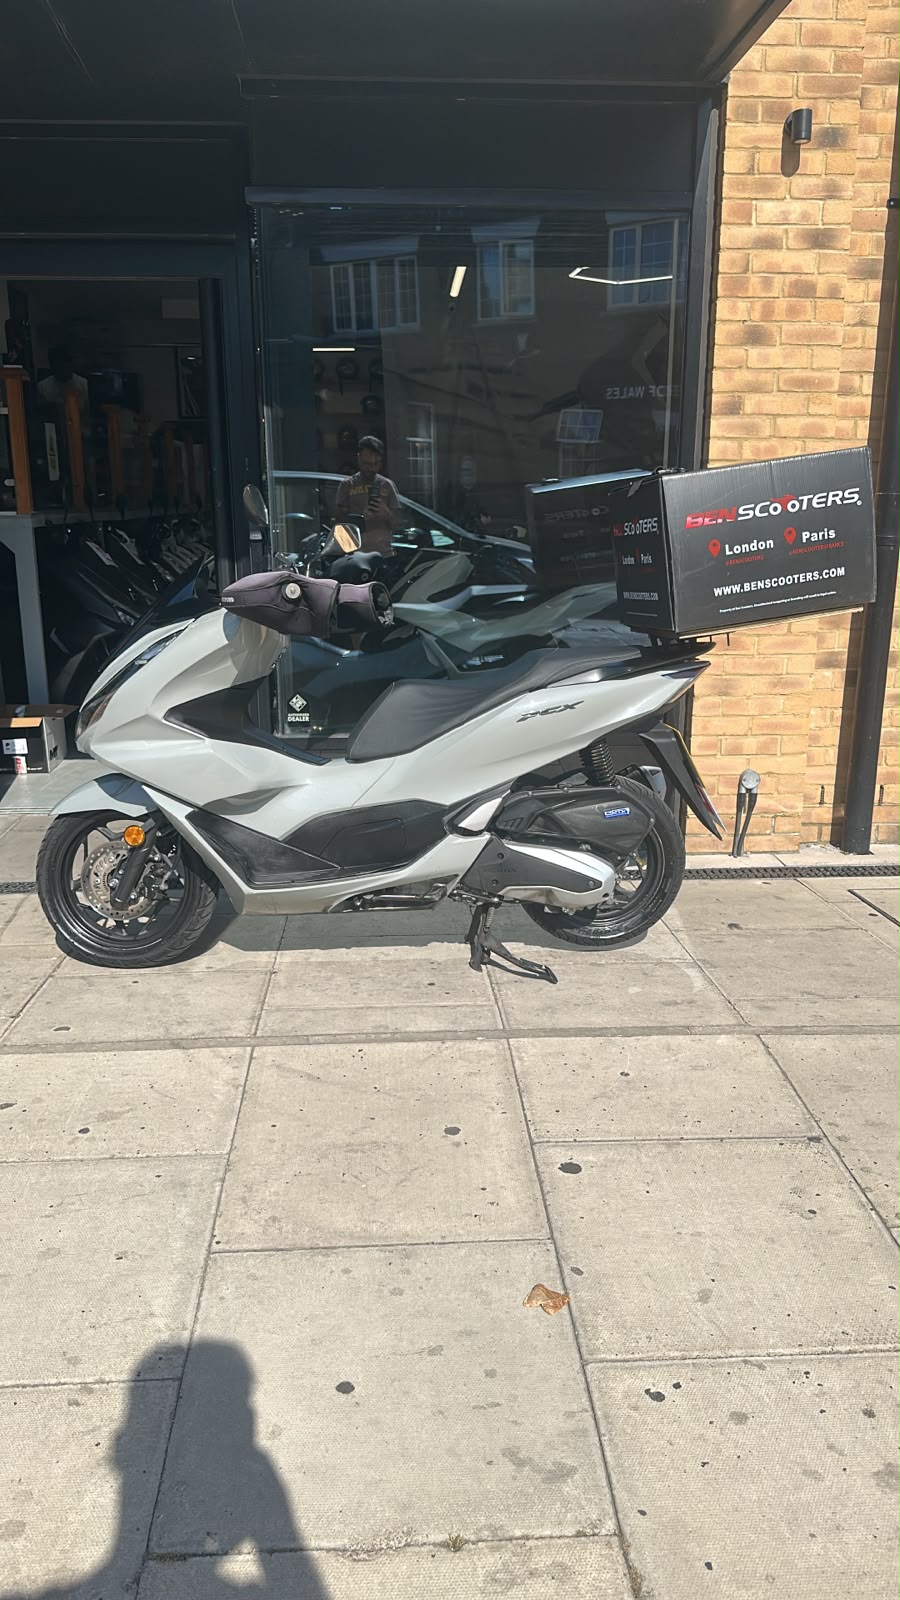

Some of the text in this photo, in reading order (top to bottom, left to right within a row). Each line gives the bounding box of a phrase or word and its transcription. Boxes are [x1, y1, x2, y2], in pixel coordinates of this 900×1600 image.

[801, 528, 836, 543] Paris
[725, 539, 774, 556] London
[641, 553, 653, 564] Paris
[713, 566, 846, 597] WWW.BENSCOOTERS.COM
